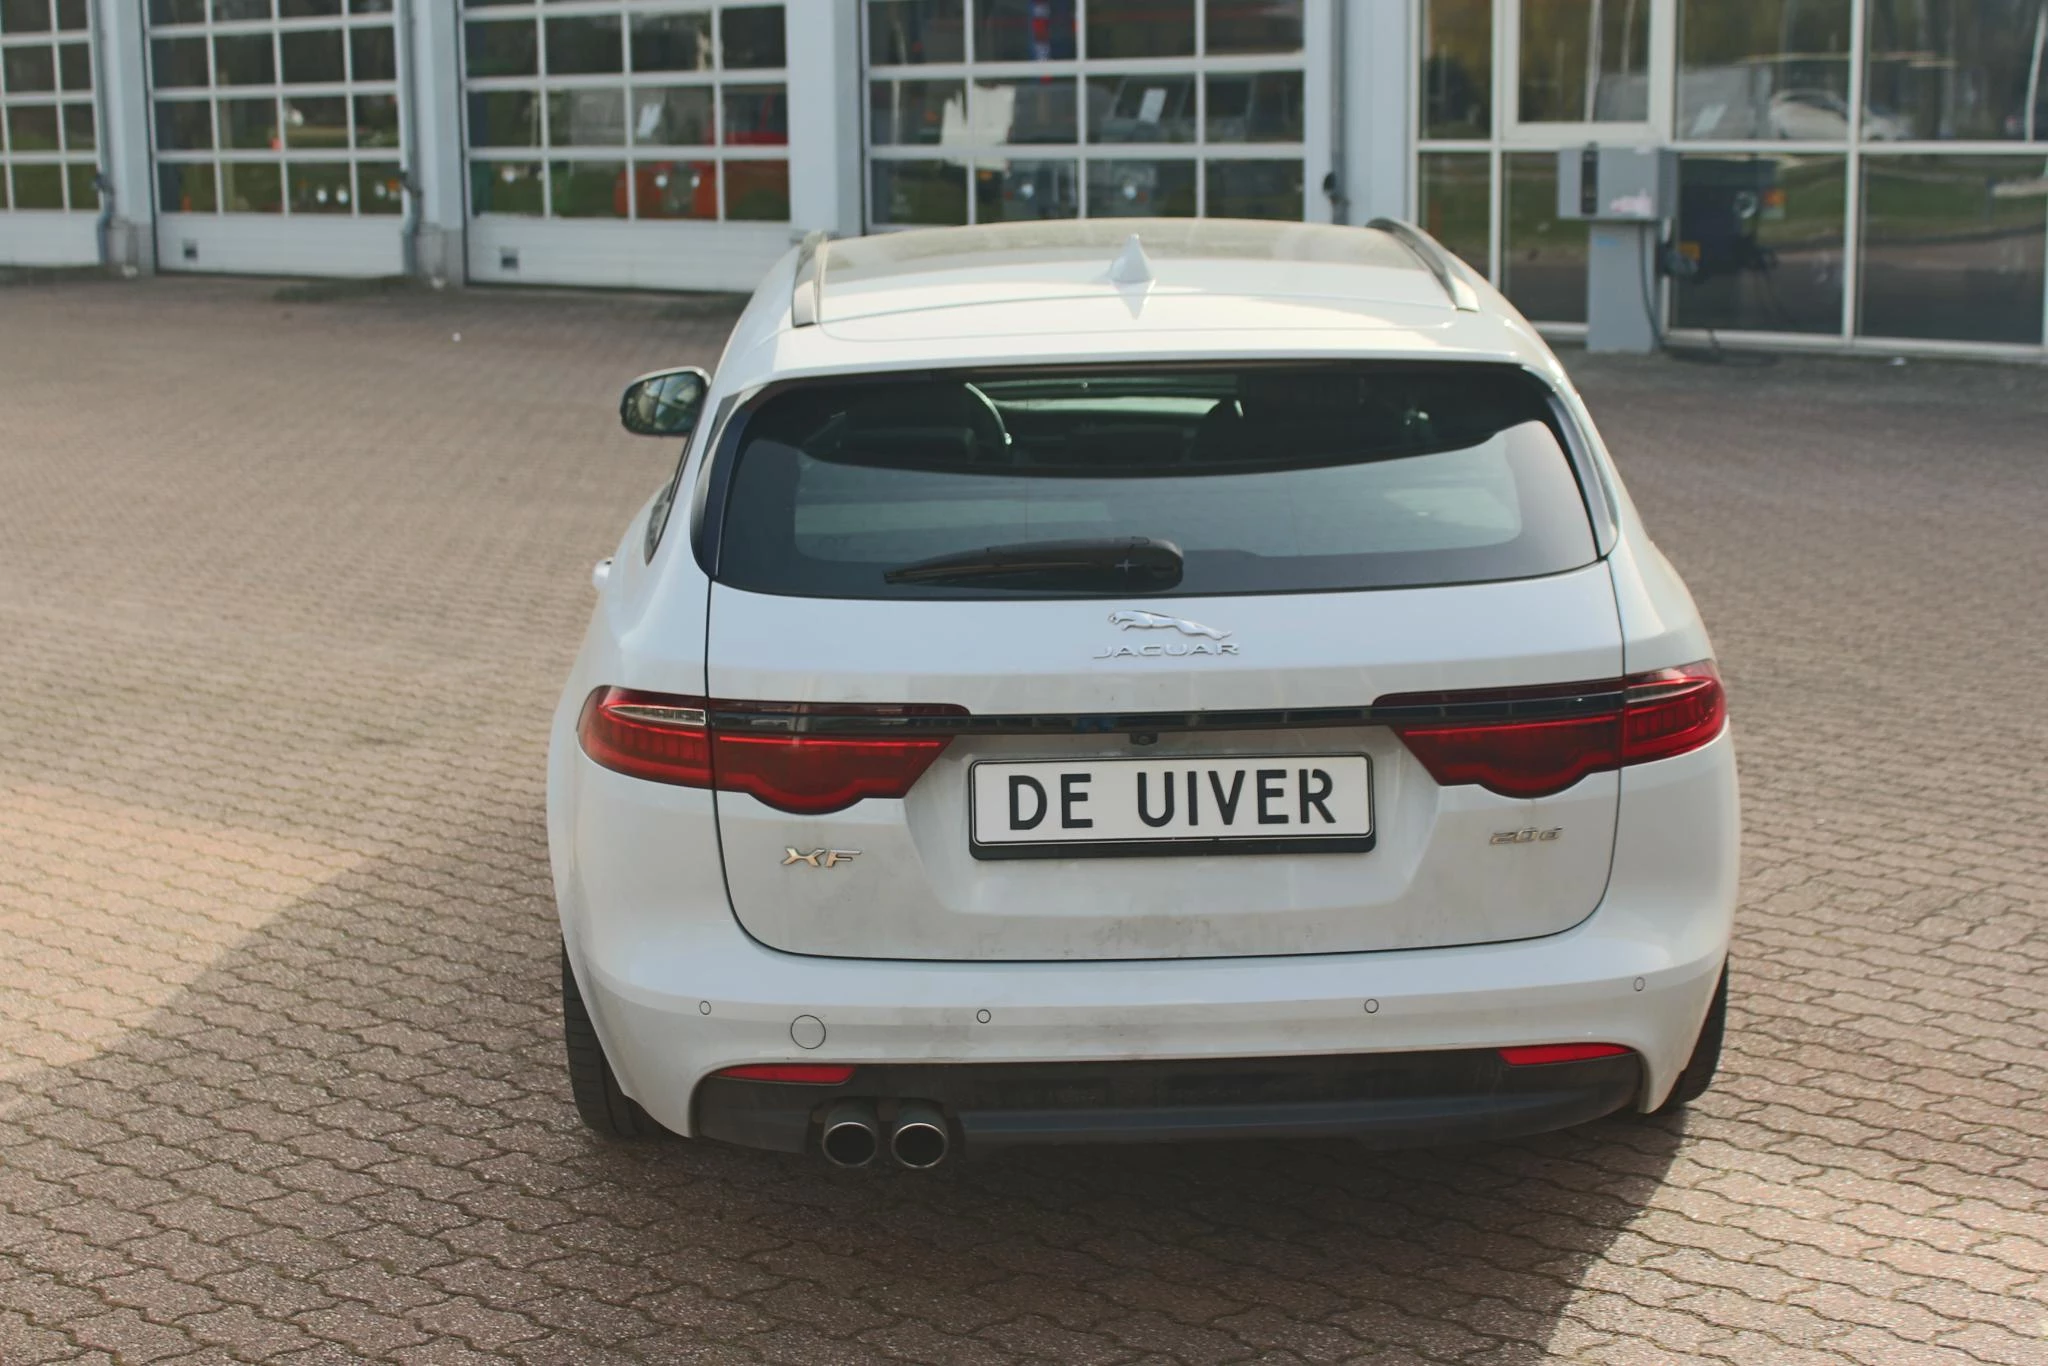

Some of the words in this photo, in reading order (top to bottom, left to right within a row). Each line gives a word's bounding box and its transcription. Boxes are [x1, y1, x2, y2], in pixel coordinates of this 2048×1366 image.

[1093, 643, 1240, 660] JAGUAR
[1008, 774, 1093, 830] DE
[1137, 769, 1337, 828] UIVER
[781, 846, 863, 868] XF
